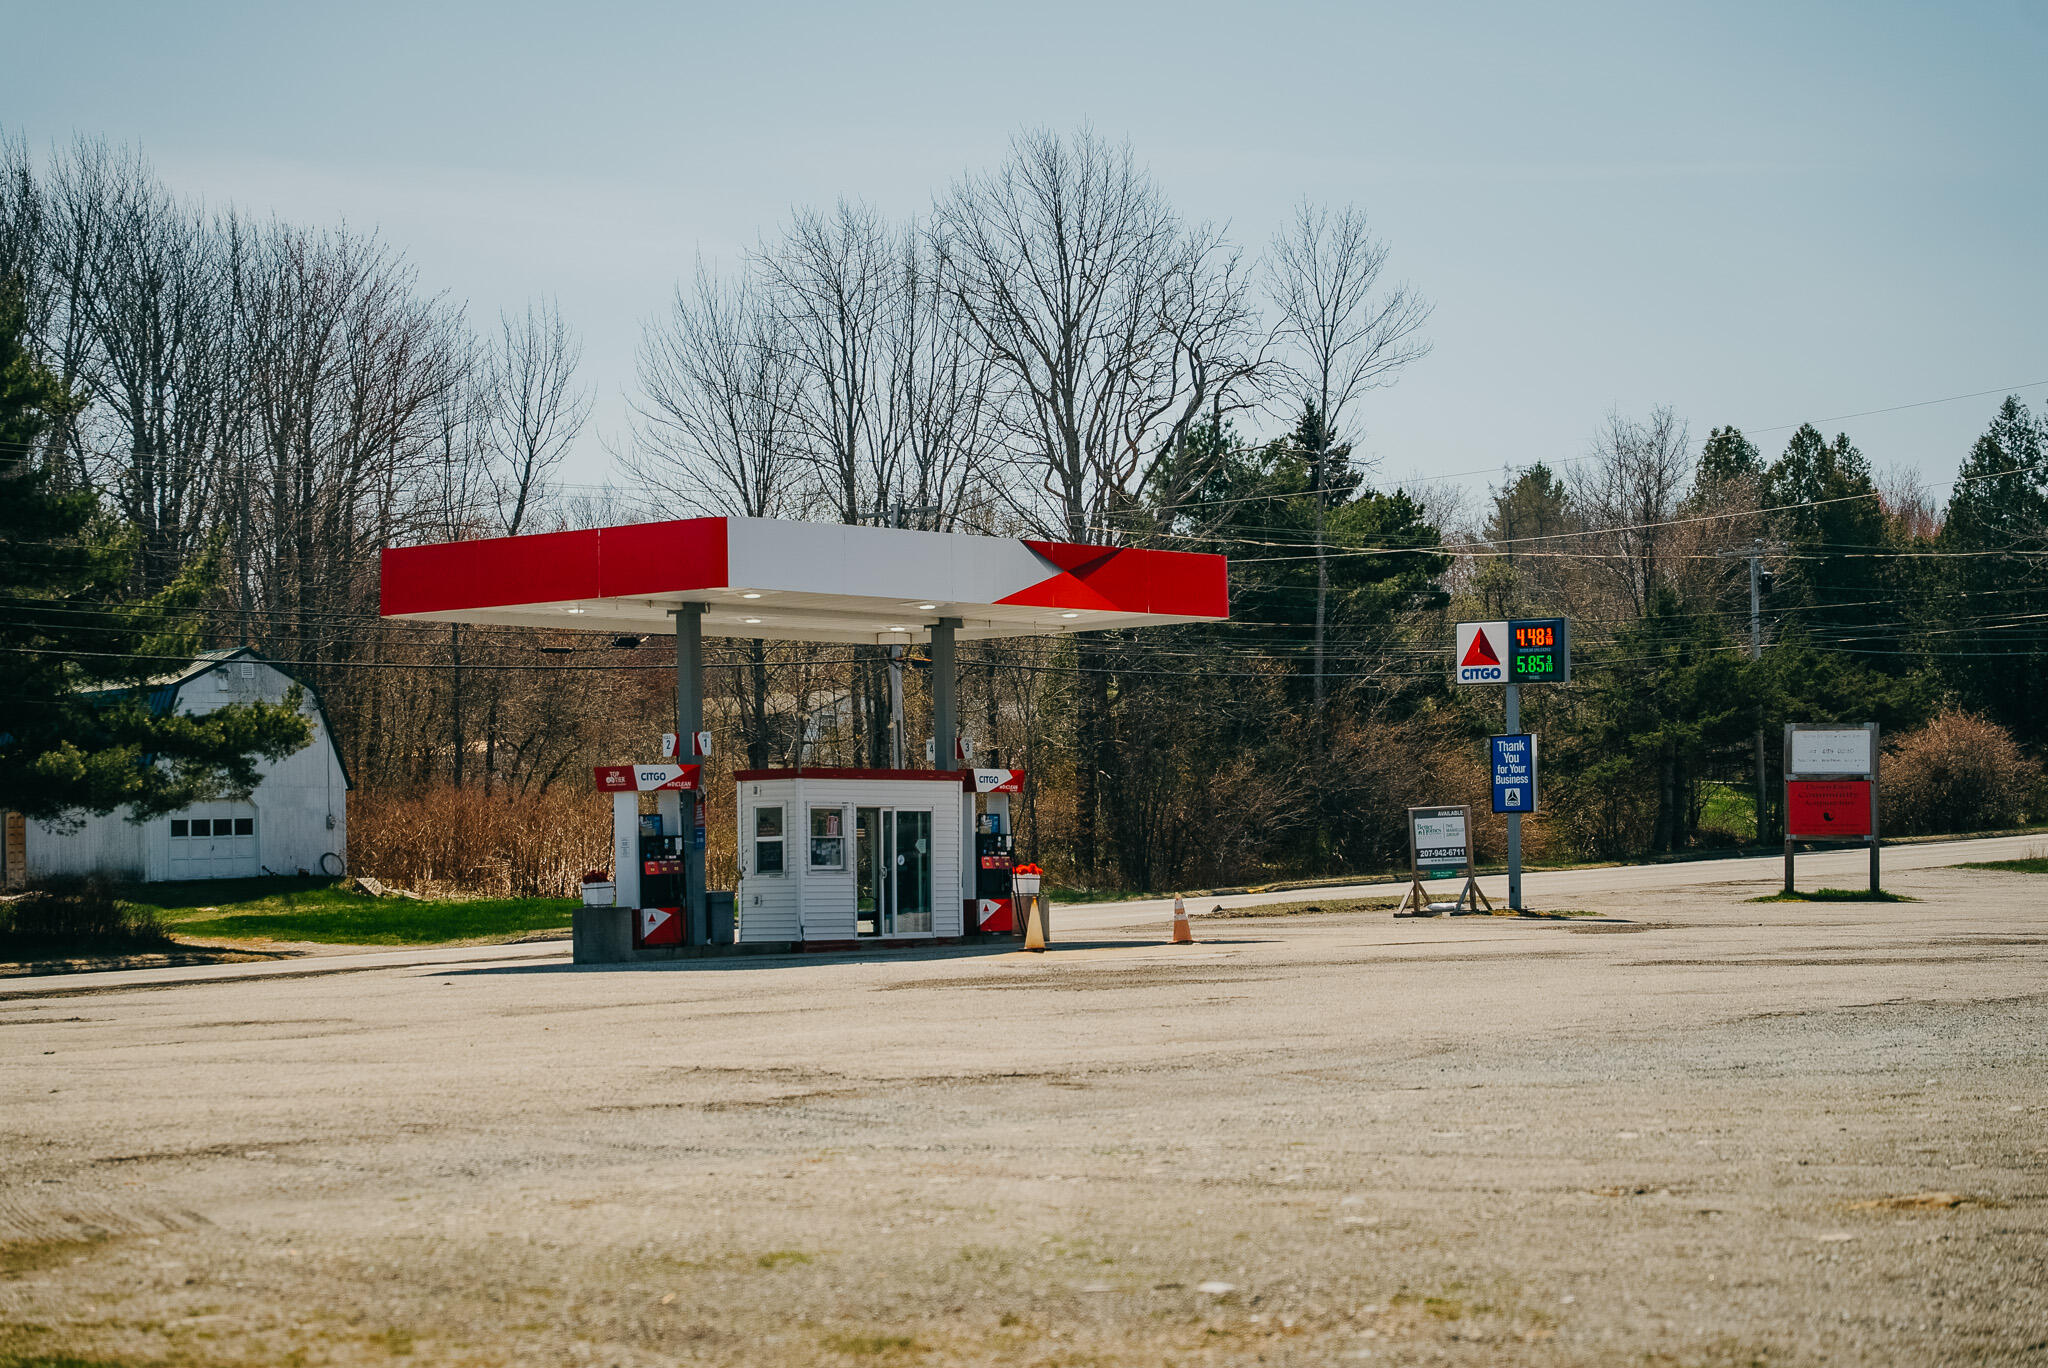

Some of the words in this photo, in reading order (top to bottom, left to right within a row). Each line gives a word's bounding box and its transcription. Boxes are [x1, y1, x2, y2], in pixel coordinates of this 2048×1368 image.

[1516, 655, 1545, 673] 5.85
[1461, 667, 1501, 680] CITGO
[666, 740, 671, 749] 2
[704, 738, 707, 748] 1
[965, 743, 970, 752] 3
[1497, 740, 1525, 752] Thank
[929, 744, 934, 753] 4
[1503, 752, 1520, 763] You
[1497, 764, 1508, 774] for
[1509, 764, 1526, 774] Your
[640, 772, 667, 781] CITGO
[978, 775, 999, 784] CITGO
[1495, 774, 1529, 785] Business
[1419, 848, 1465, 858] 207-942-6711
